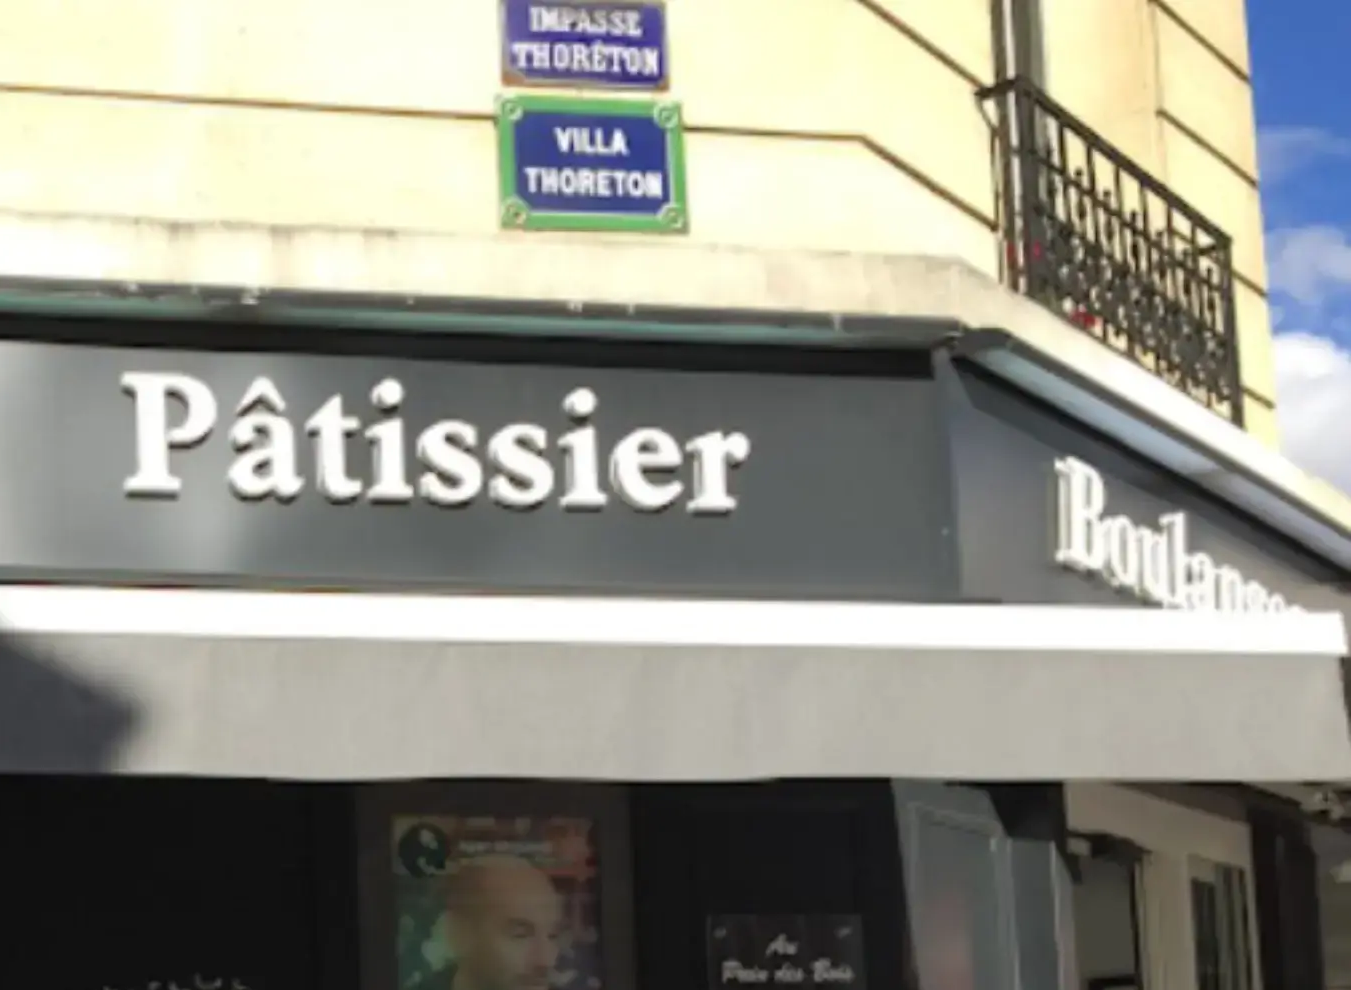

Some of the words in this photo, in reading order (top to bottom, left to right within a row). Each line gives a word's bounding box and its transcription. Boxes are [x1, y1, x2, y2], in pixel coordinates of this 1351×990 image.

[530, 6, 643, 38] IMPASSE
[554, 127, 630, 156] VILLA
[120, 371, 751, 513] Pâtissier
[1054, 455, 1309, 613] Boulan
